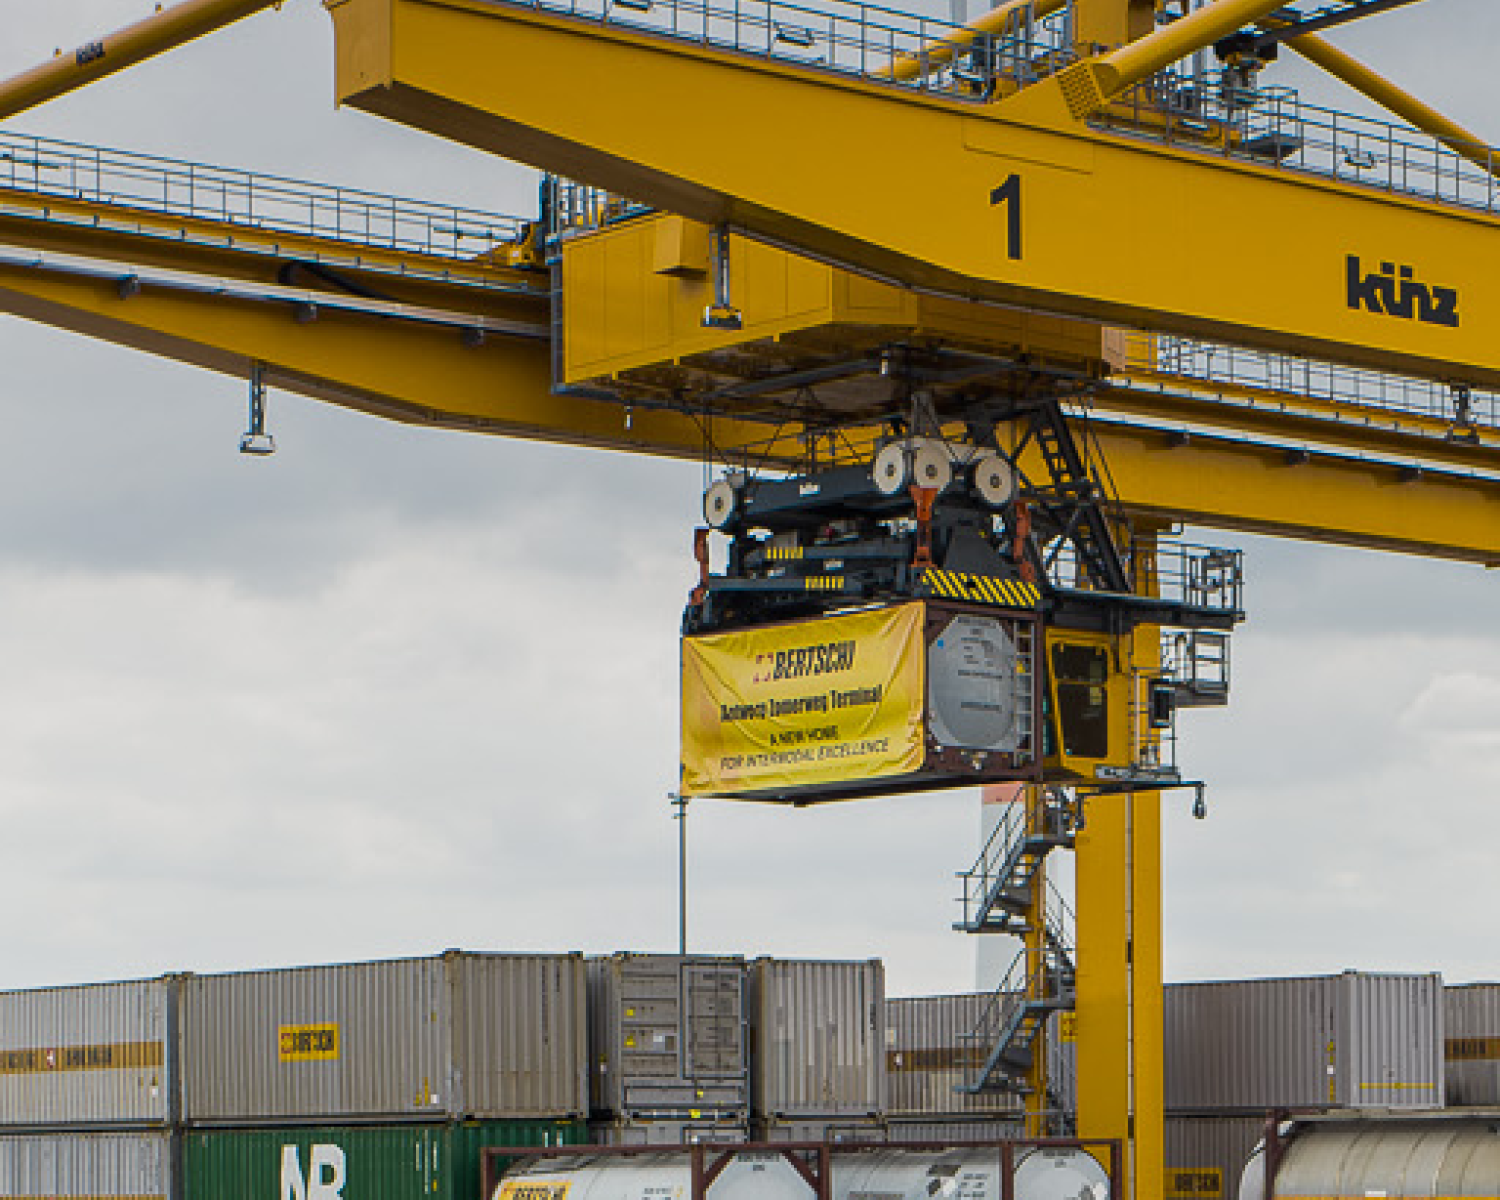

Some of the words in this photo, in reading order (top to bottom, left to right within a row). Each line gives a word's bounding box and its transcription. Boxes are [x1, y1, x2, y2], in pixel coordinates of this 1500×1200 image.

[990, 173, 1022, 260] 1
[1346, 254, 1459, 327] künz
[773, 640, 856, 681] BERTSCHI
[831, 684, 882, 709] Terminal
[770, 734, 777, 746] A
[779, 730, 805, 744] NEW
[817, 737, 889, 760] EXCELLENCE
